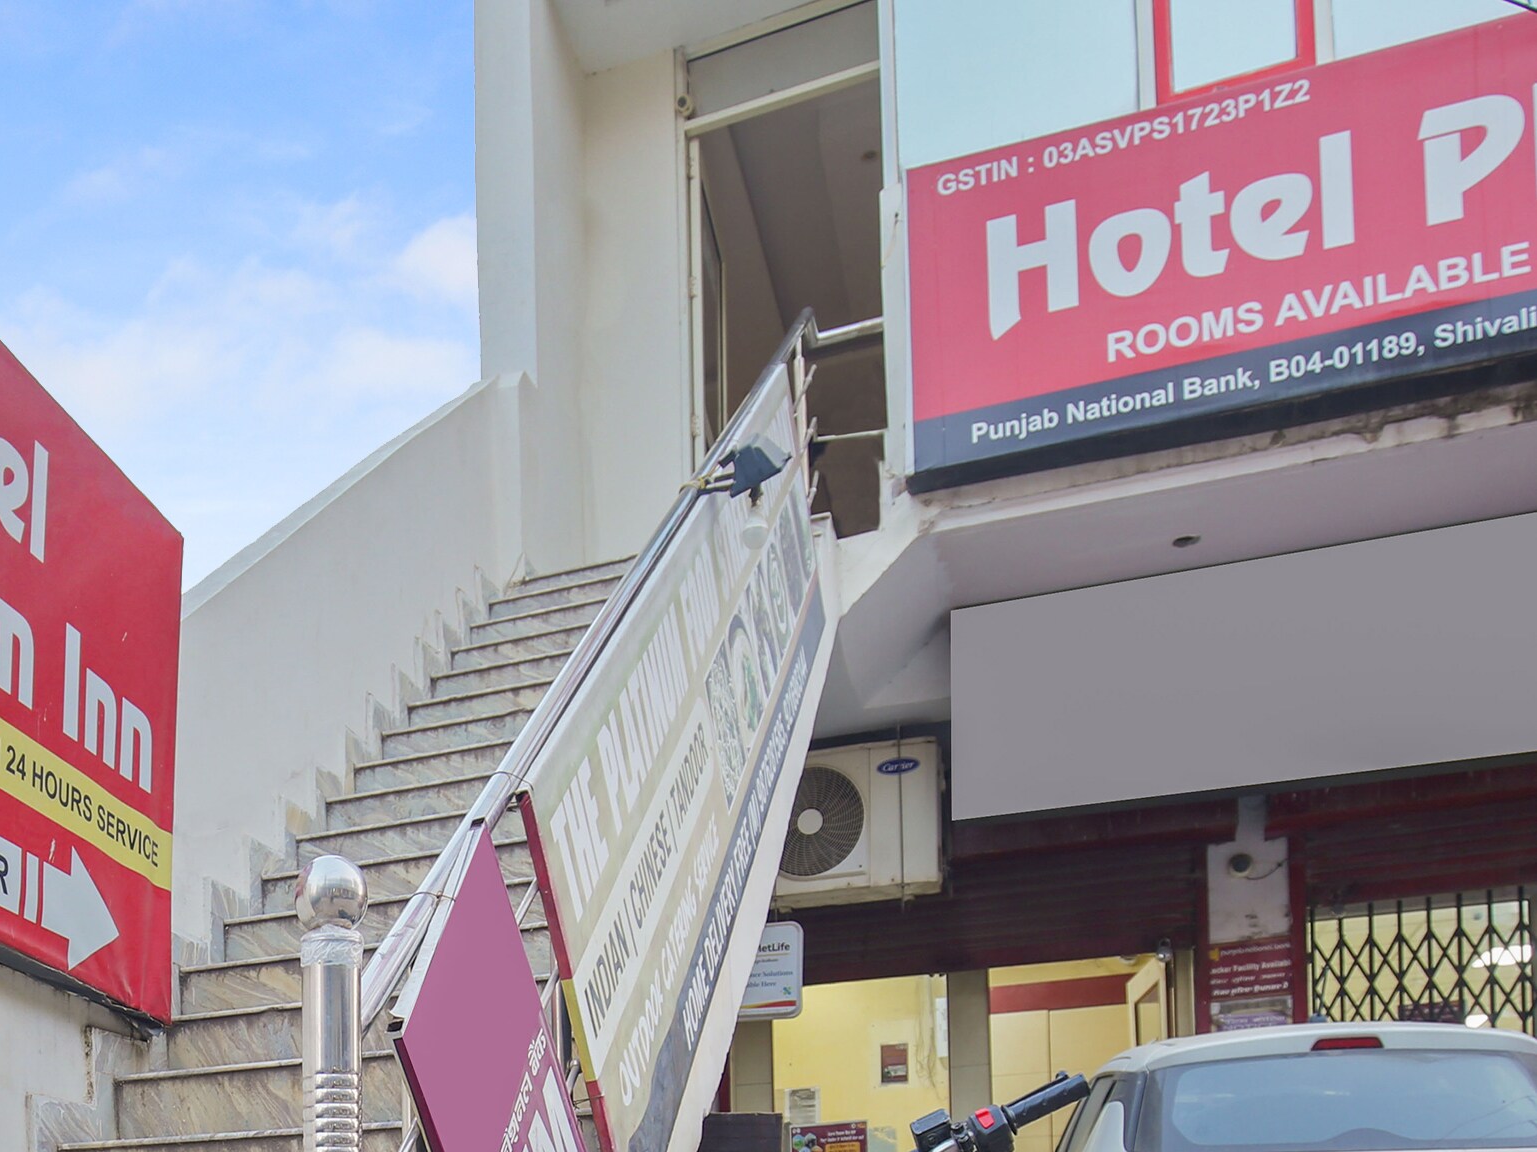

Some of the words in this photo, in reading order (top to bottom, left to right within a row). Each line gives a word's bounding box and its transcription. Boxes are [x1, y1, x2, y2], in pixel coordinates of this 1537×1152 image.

[936, 157, 1018, 196] GSTIN
[1043, 79, 1311, 170] 03ASVPS1723P1Z2
[986, 130, 1355, 341] Hotel
[1417, 82, 1537, 227] P
[971, 408, 1059, 444] Punjab
[1067, 383, 1175, 424] National
[1183, 366, 1261, 402] Bank,
[1268, 333, 1425, 384] B04-01189,
[1107, 302, 1263, 363] ROOMS
[1276, 241, 1532, 328] AVAILABLE
[5, 744, 27, 778] 24
[31, 760, 93, 824] HOURS
[95, 800, 160, 869] SERVICE
[63, 622, 153, 794] Inn
[550, 754, 610, 923] THE
[596, 602, 689, 837] PLATINUM
[679, 540, 720, 673] FOOD
[584, 911, 632, 1040] INDIAN
[629, 815, 672, 930] CHINESE
[669, 720, 710, 832] TANDOOR
[682, 973, 711, 1051] HOME
[702, 860, 740, 985] DELIVERY
[735, 815, 754, 888] FREE
[617, 967, 663, 1107] OUTDOOR
[661, 876, 699, 991] CATERING
